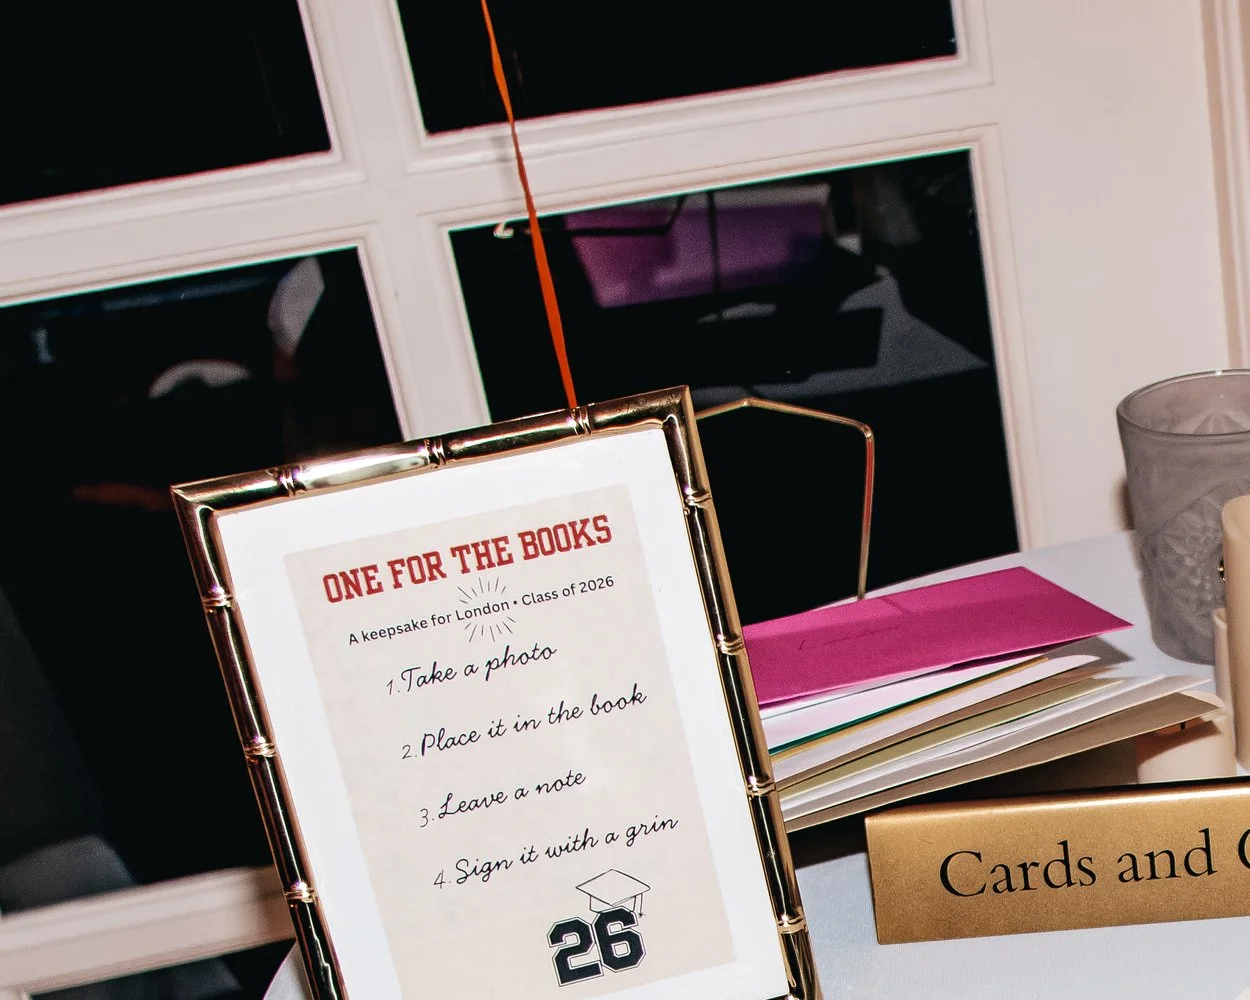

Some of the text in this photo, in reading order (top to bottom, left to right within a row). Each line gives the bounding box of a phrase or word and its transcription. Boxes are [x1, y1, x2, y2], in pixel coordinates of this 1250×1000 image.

[322, 514, 612, 603] ONE FOR THE BOOKS
[349, 575, 614, 645] A keepsake for London Class of 2026
[463, 661, 478, 676] a
[485, 644, 557, 682] photo
[420, 726, 481, 757] Place
[487, 719, 507, 739] it
[512, 711, 541, 732] in
[547, 699, 584, 726] the
[589, 683, 648, 717] book
[437, 790, 508, 820] Leave
[514, 785, 529, 800] a
[535, 768, 587, 794] note
[454, 855, 513, 886] Sign
[519, 844, 539, 865] it
[544, 831, 600, 860] with
[604, 829, 619, 844] a
[625, 814, 679, 849] grin
[939, 840, 1098, 897] Cards
[1117, 828, 1218, 884] and
[546, 905, 647, 987] 26
